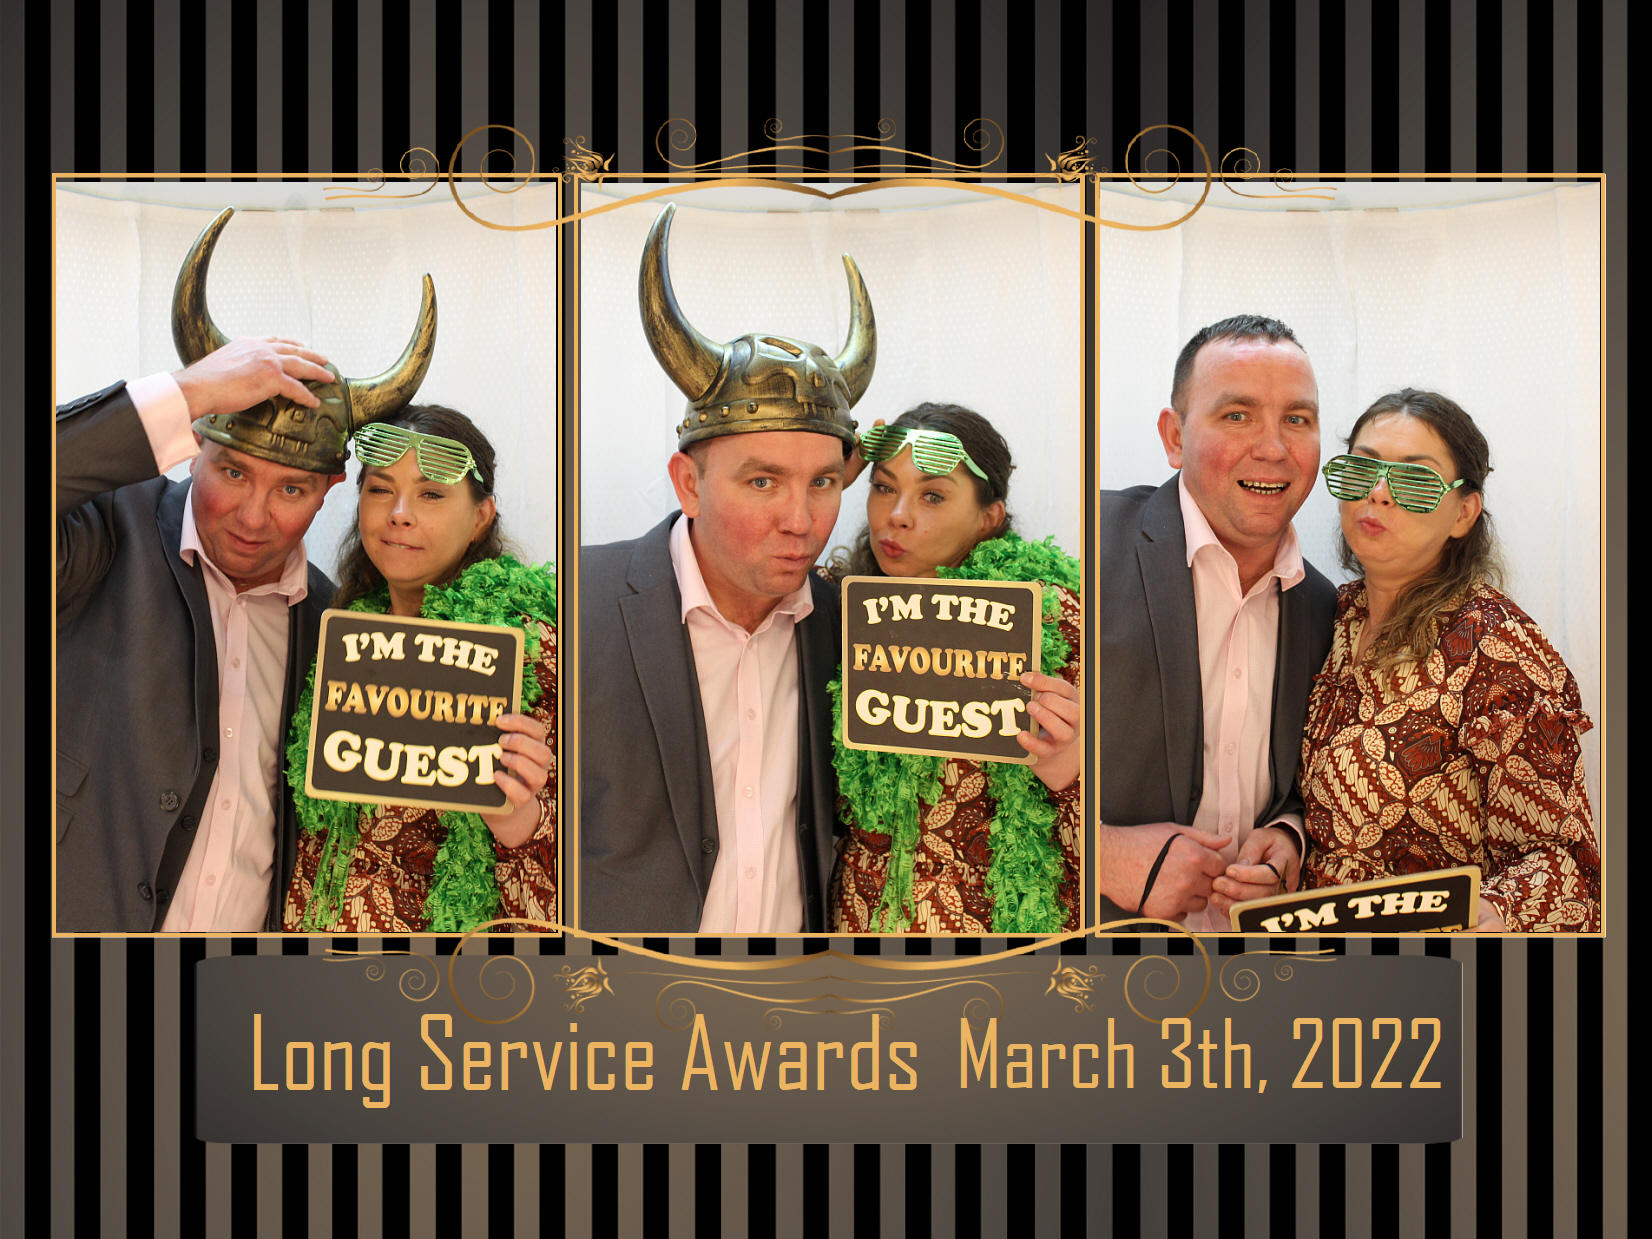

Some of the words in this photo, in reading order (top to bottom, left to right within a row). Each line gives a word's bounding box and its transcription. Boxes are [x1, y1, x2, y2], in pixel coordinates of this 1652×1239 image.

[863, 594, 924, 625] I'M
[931, 594, 1016, 631] THE
[342, 632, 406, 662] I'M
[414, 633, 499, 676] THE
[852, 643, 1027, 681] FAVOURITE
[324, 680, 508, 726] FAVOURITE
[855, 689, 1026, 738] GUEST
[323, 730, 503, 787] GUEST
[1348, 890, 1450, 919] THE
